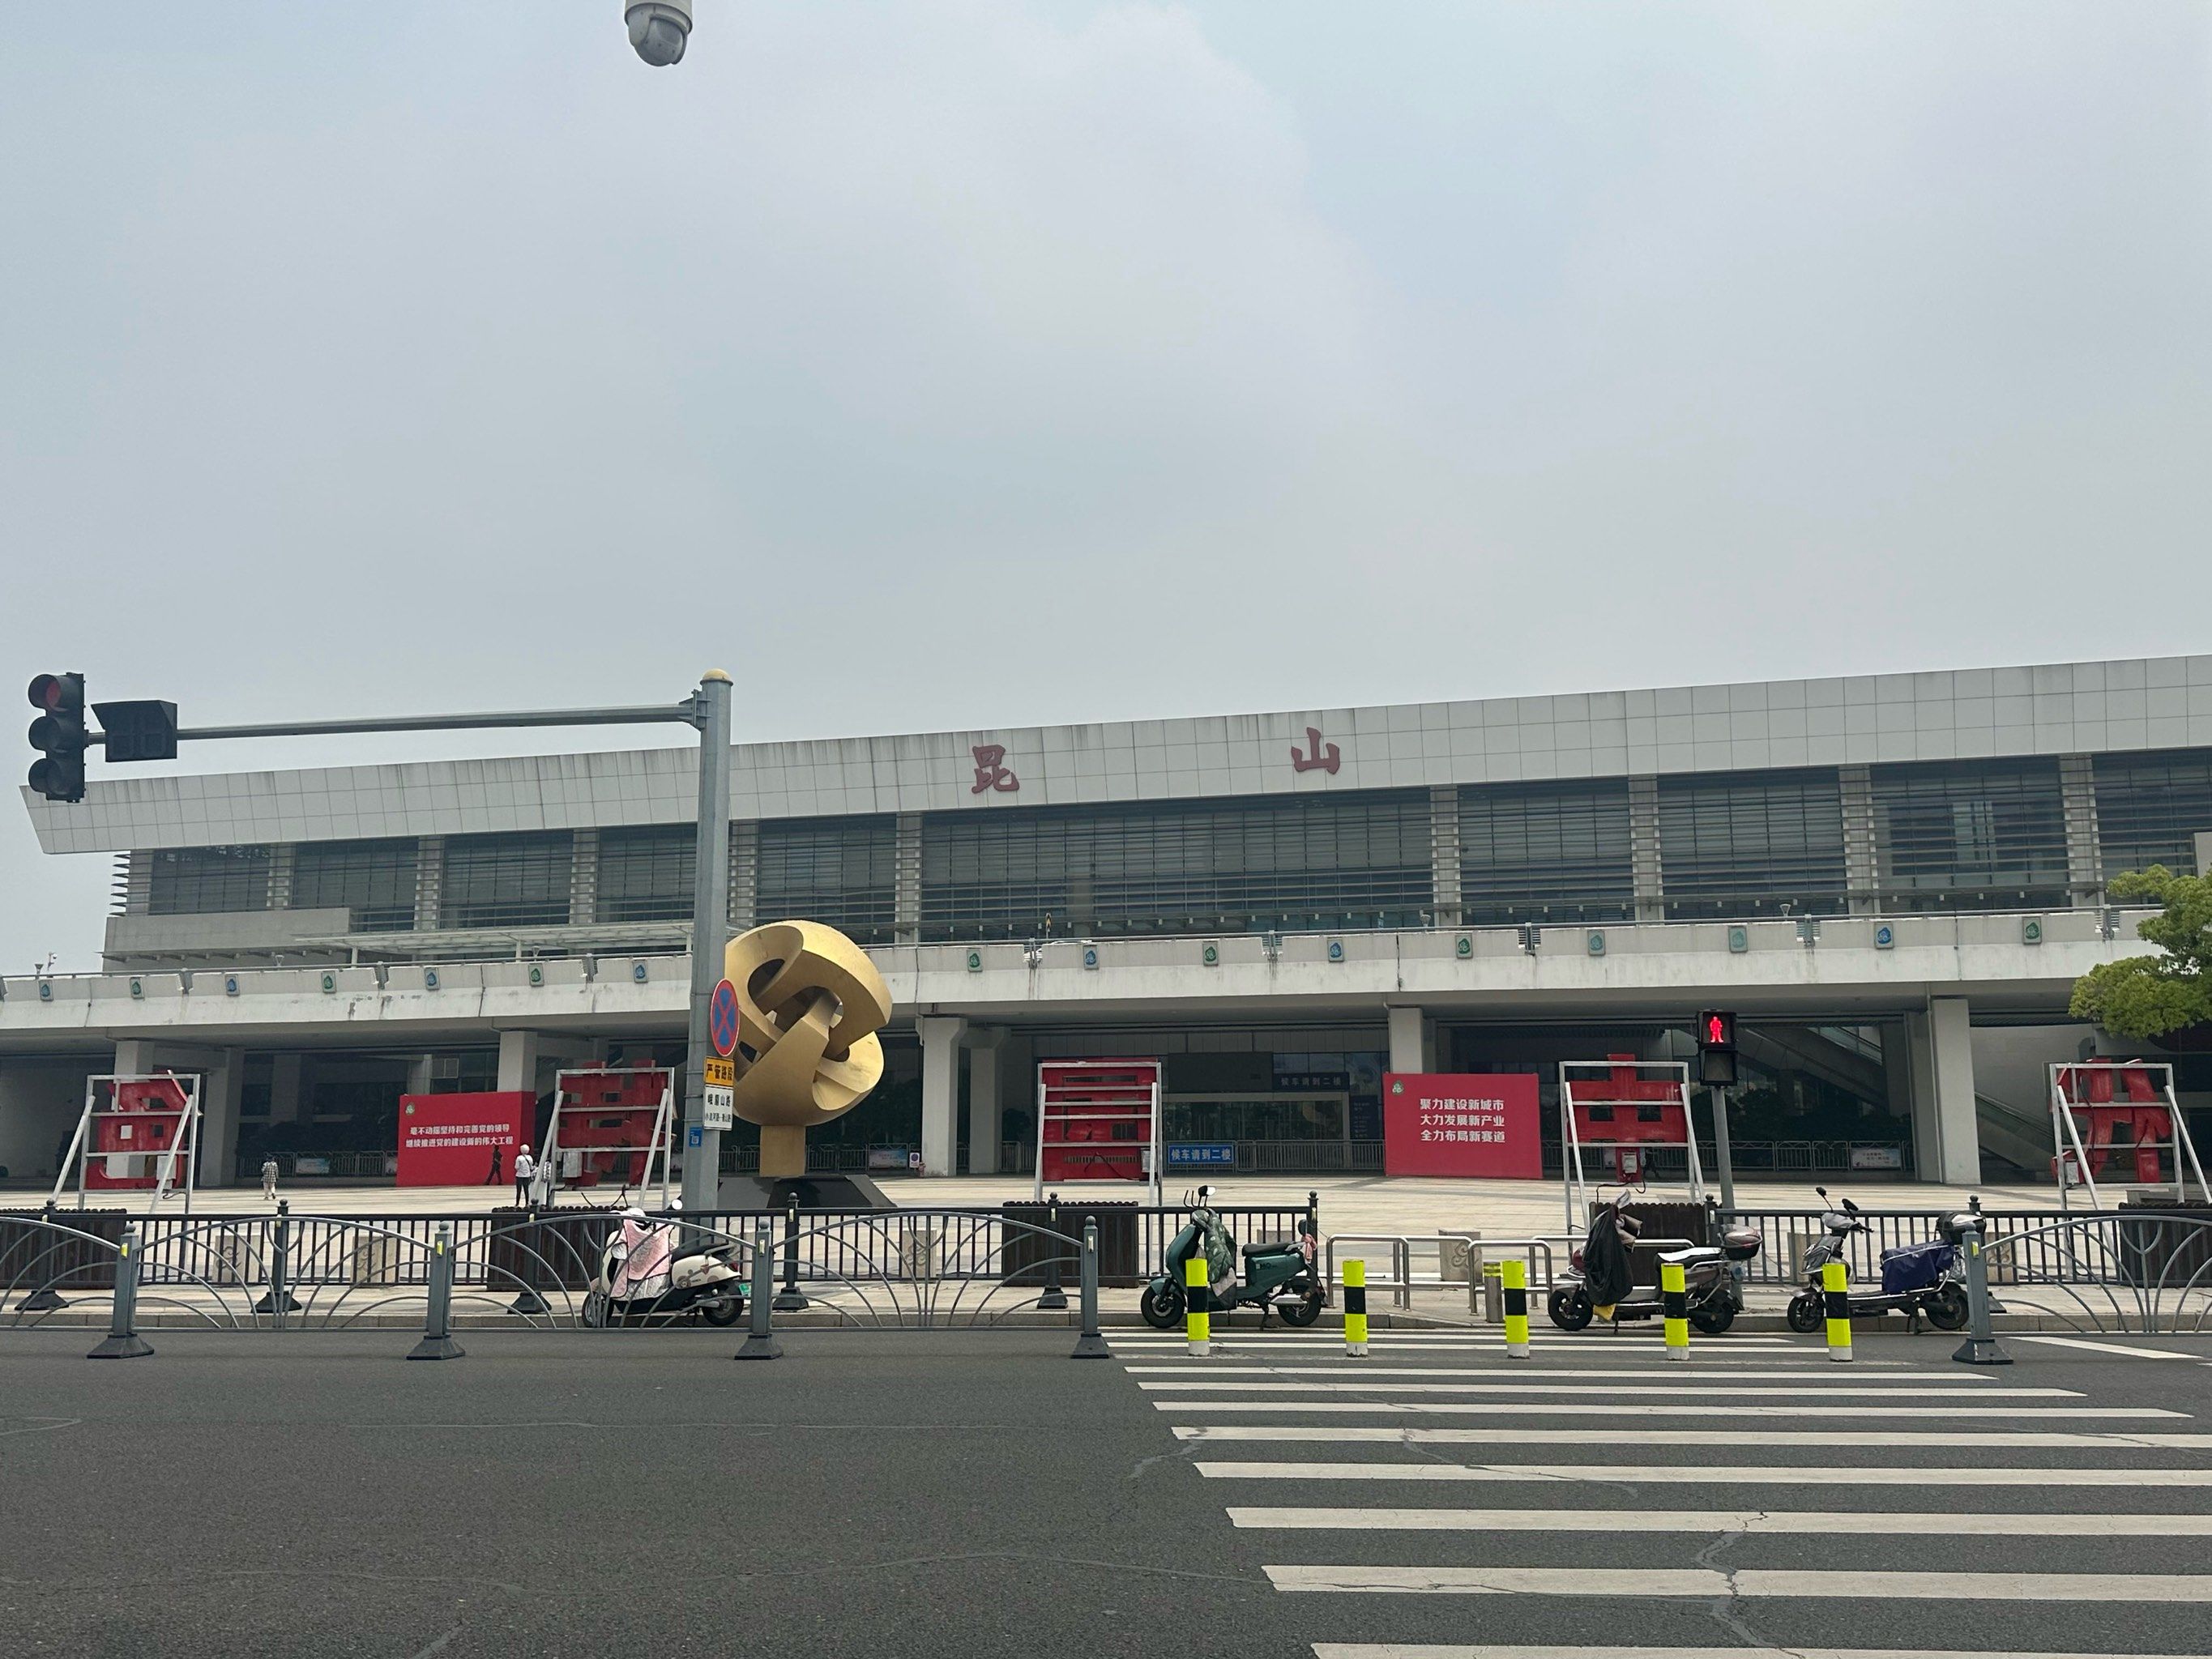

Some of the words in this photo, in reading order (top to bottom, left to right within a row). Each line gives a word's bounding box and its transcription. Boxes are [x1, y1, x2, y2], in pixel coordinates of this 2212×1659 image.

[972, 727, 1340, 793] 昆山
[1420, 1098, 1505, 1111] 聚力建设新城市
[1420, 1114, 1505, 1127] 大力发展新产业
[1420, 1129, 1505, 1143] 全力布局新赛道
[1171, 1149, 1231, 1161] 候车请到二楼
